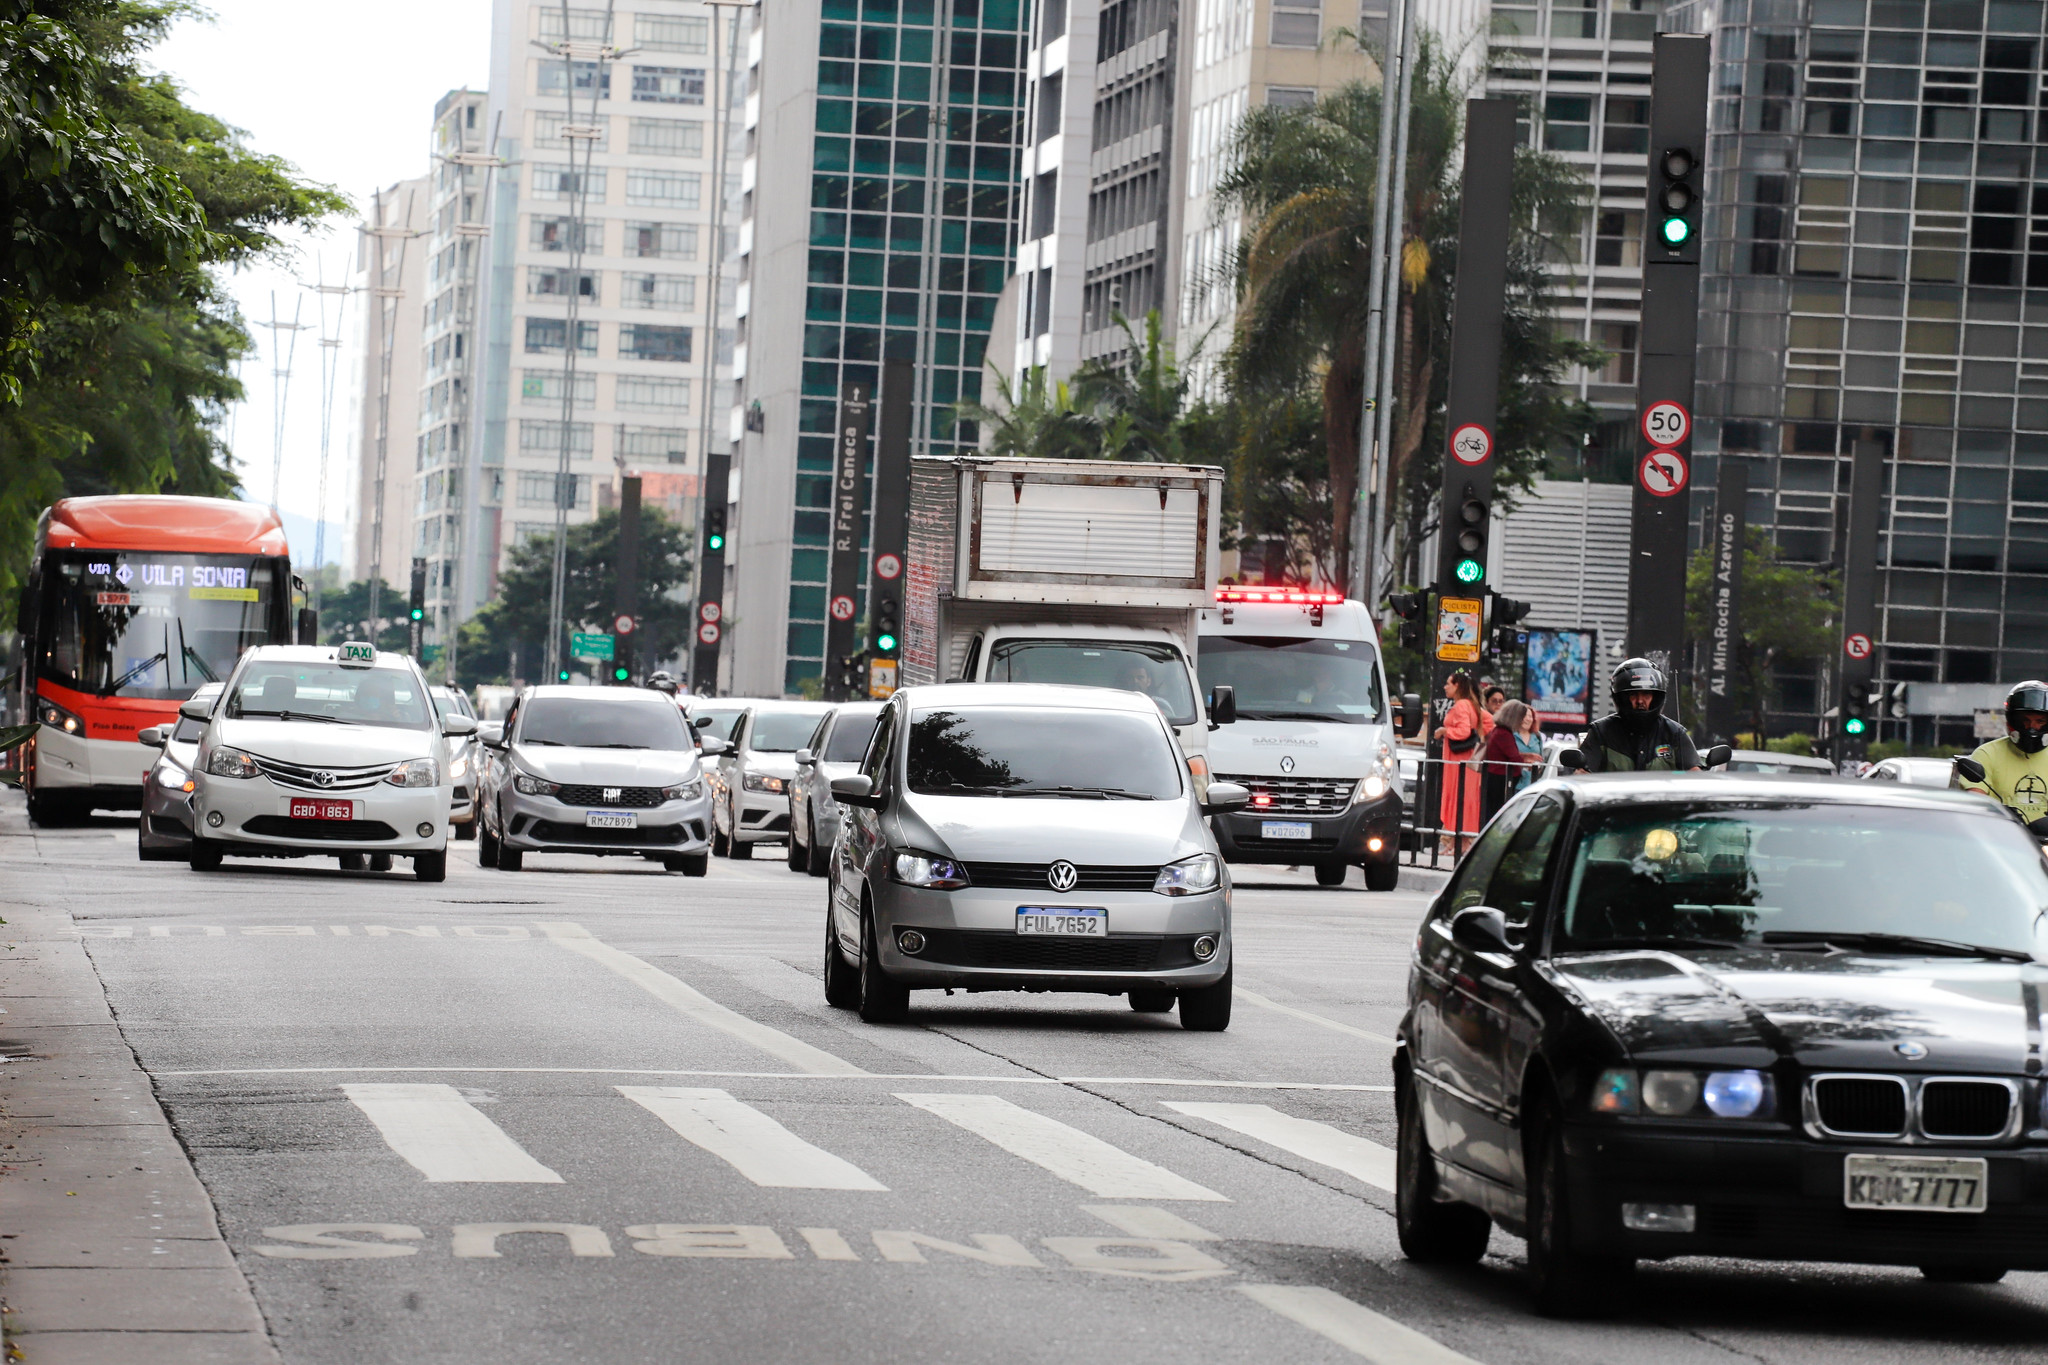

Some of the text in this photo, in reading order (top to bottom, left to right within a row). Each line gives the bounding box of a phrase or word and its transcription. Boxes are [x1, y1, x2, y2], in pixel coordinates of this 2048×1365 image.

[1651, 411, 1682, 432] 50
[837, 427, 857, 552] R. Frei Caneca
[1717, 513, 1734, 584] Azevedo
[88, 563, 246, 588] VIA VILA SONIA
[1444, 602, 1478, 610] CICLISTA
[345, 646, 372, 658] TAXI
[1279, 738, 1319, 746] PAULO
[603, 788, 621, 802] FIAT
[591, 816, 632, 826] RMZ7B99
[1024, 916, 1097, 934] FUL7G52
